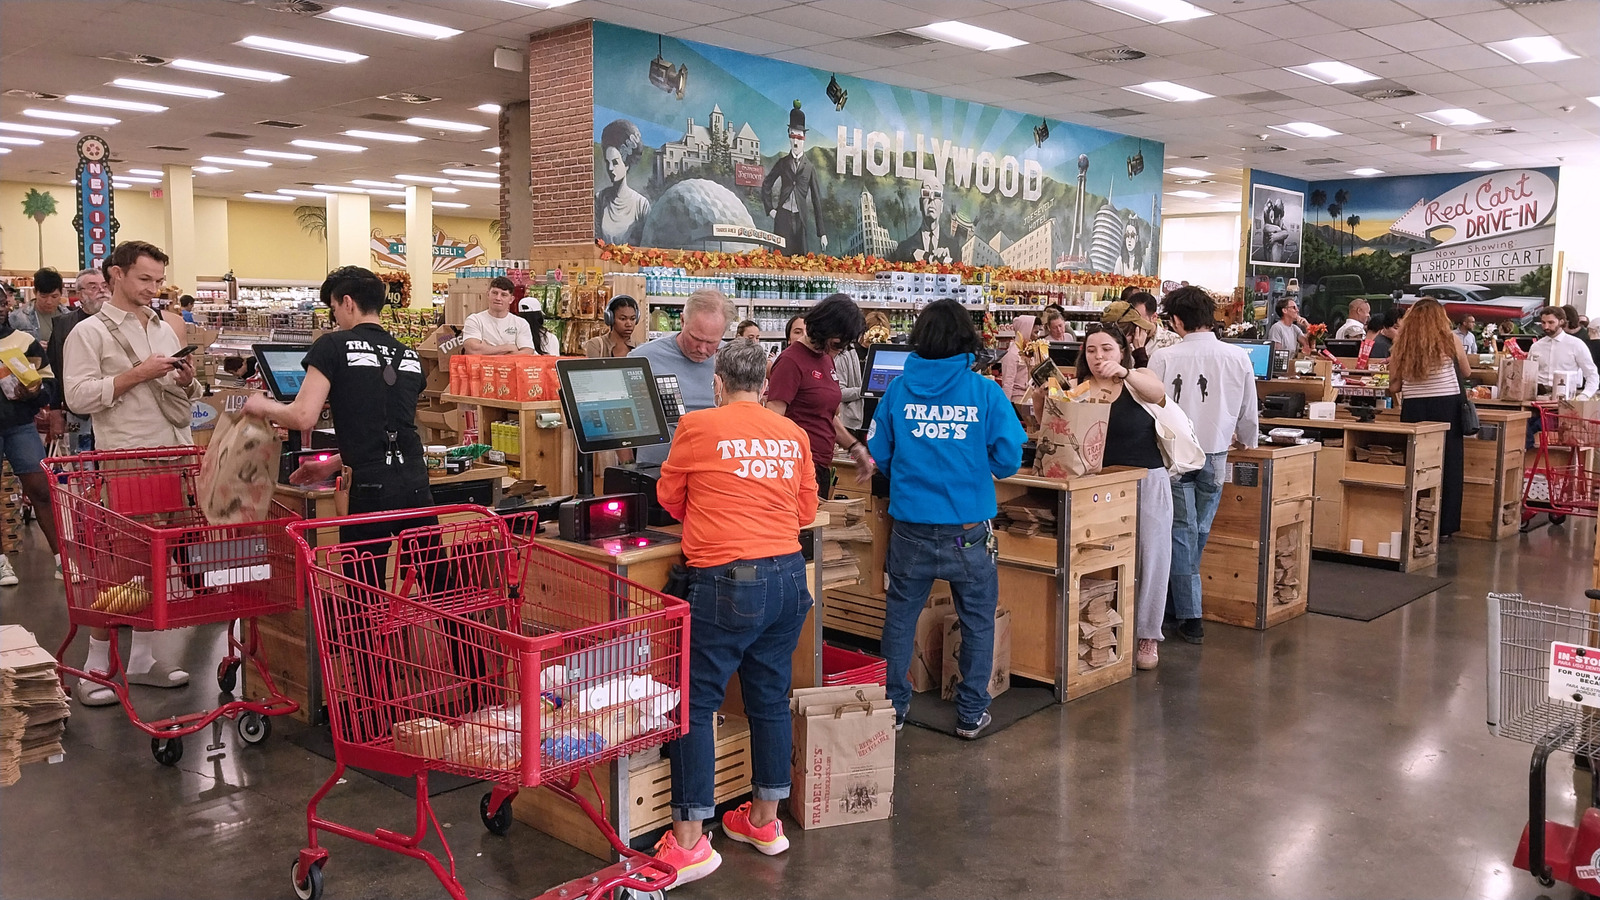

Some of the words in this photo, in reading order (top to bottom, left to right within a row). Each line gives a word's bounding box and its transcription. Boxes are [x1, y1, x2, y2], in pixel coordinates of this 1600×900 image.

[836, 125, 1043, 202] HOLLYWOOD
[89, 163, 104, 205] NEW
[1425, 193, 1473, 226] Red
[1476, 173, 1533, 212] Cart
[1028, 214, 1047, 232] HOTEL
[1466, 200, 1538, 239] DRIVE-IN
[440, 244, 457, 256] DELI
[1435, 250, 1457, 259] Now
[1416, 263, 1422, 273] A
[1429, 254, 1491, 271] SHOPPING
[1501, 248, 1545, 266] CART
[1422, 272, 1456, 283] NAMED
[1465, 268, 1516, 282] DESIRE
[438, 335, 464, 354] TOTE
[903, 403, 980, 422] TRADER
[911, 421, 969, 440] JOE'S
[716, 438, 803, 460] TRADER
[733, 458, 795, 479] JOE'S
[1558, 651, 1600, 667] IN-STO
[1558, 668, 1573, 676] FOR
[1575, 671, 1591, 679] OUR
[813, 747, 823, 780] JOE'S
[812, 782, 822, 825] TRADER
